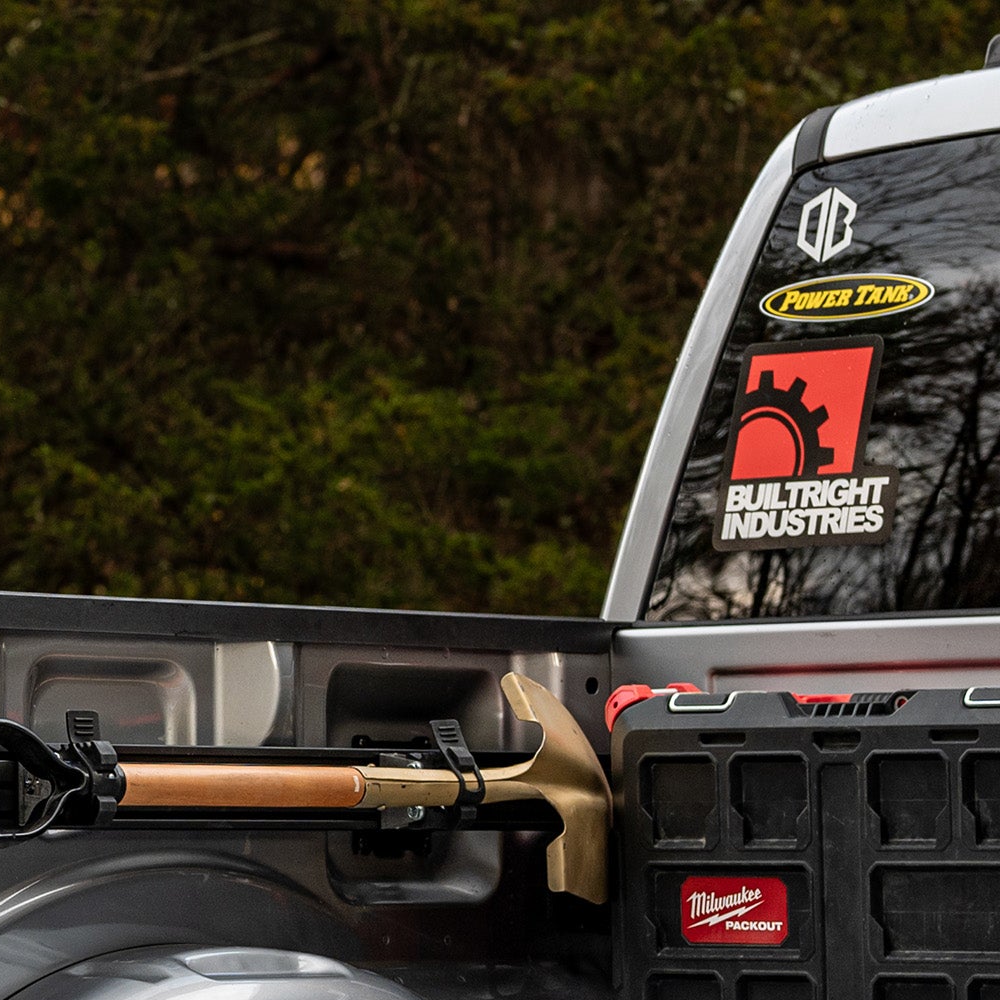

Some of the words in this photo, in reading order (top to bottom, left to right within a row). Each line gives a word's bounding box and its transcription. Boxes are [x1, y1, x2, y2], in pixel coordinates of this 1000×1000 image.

[778, 288, 852, 312] POWER
[853, 284, 914, 307] TANK
[725, 476, 890, 512] BUILTRIGHT
[721, 505, 884, 540] INDUSTRIES
[686, 886, 762, 919] Milwaukee
[725, 920, 783, 931] PACKOUT
